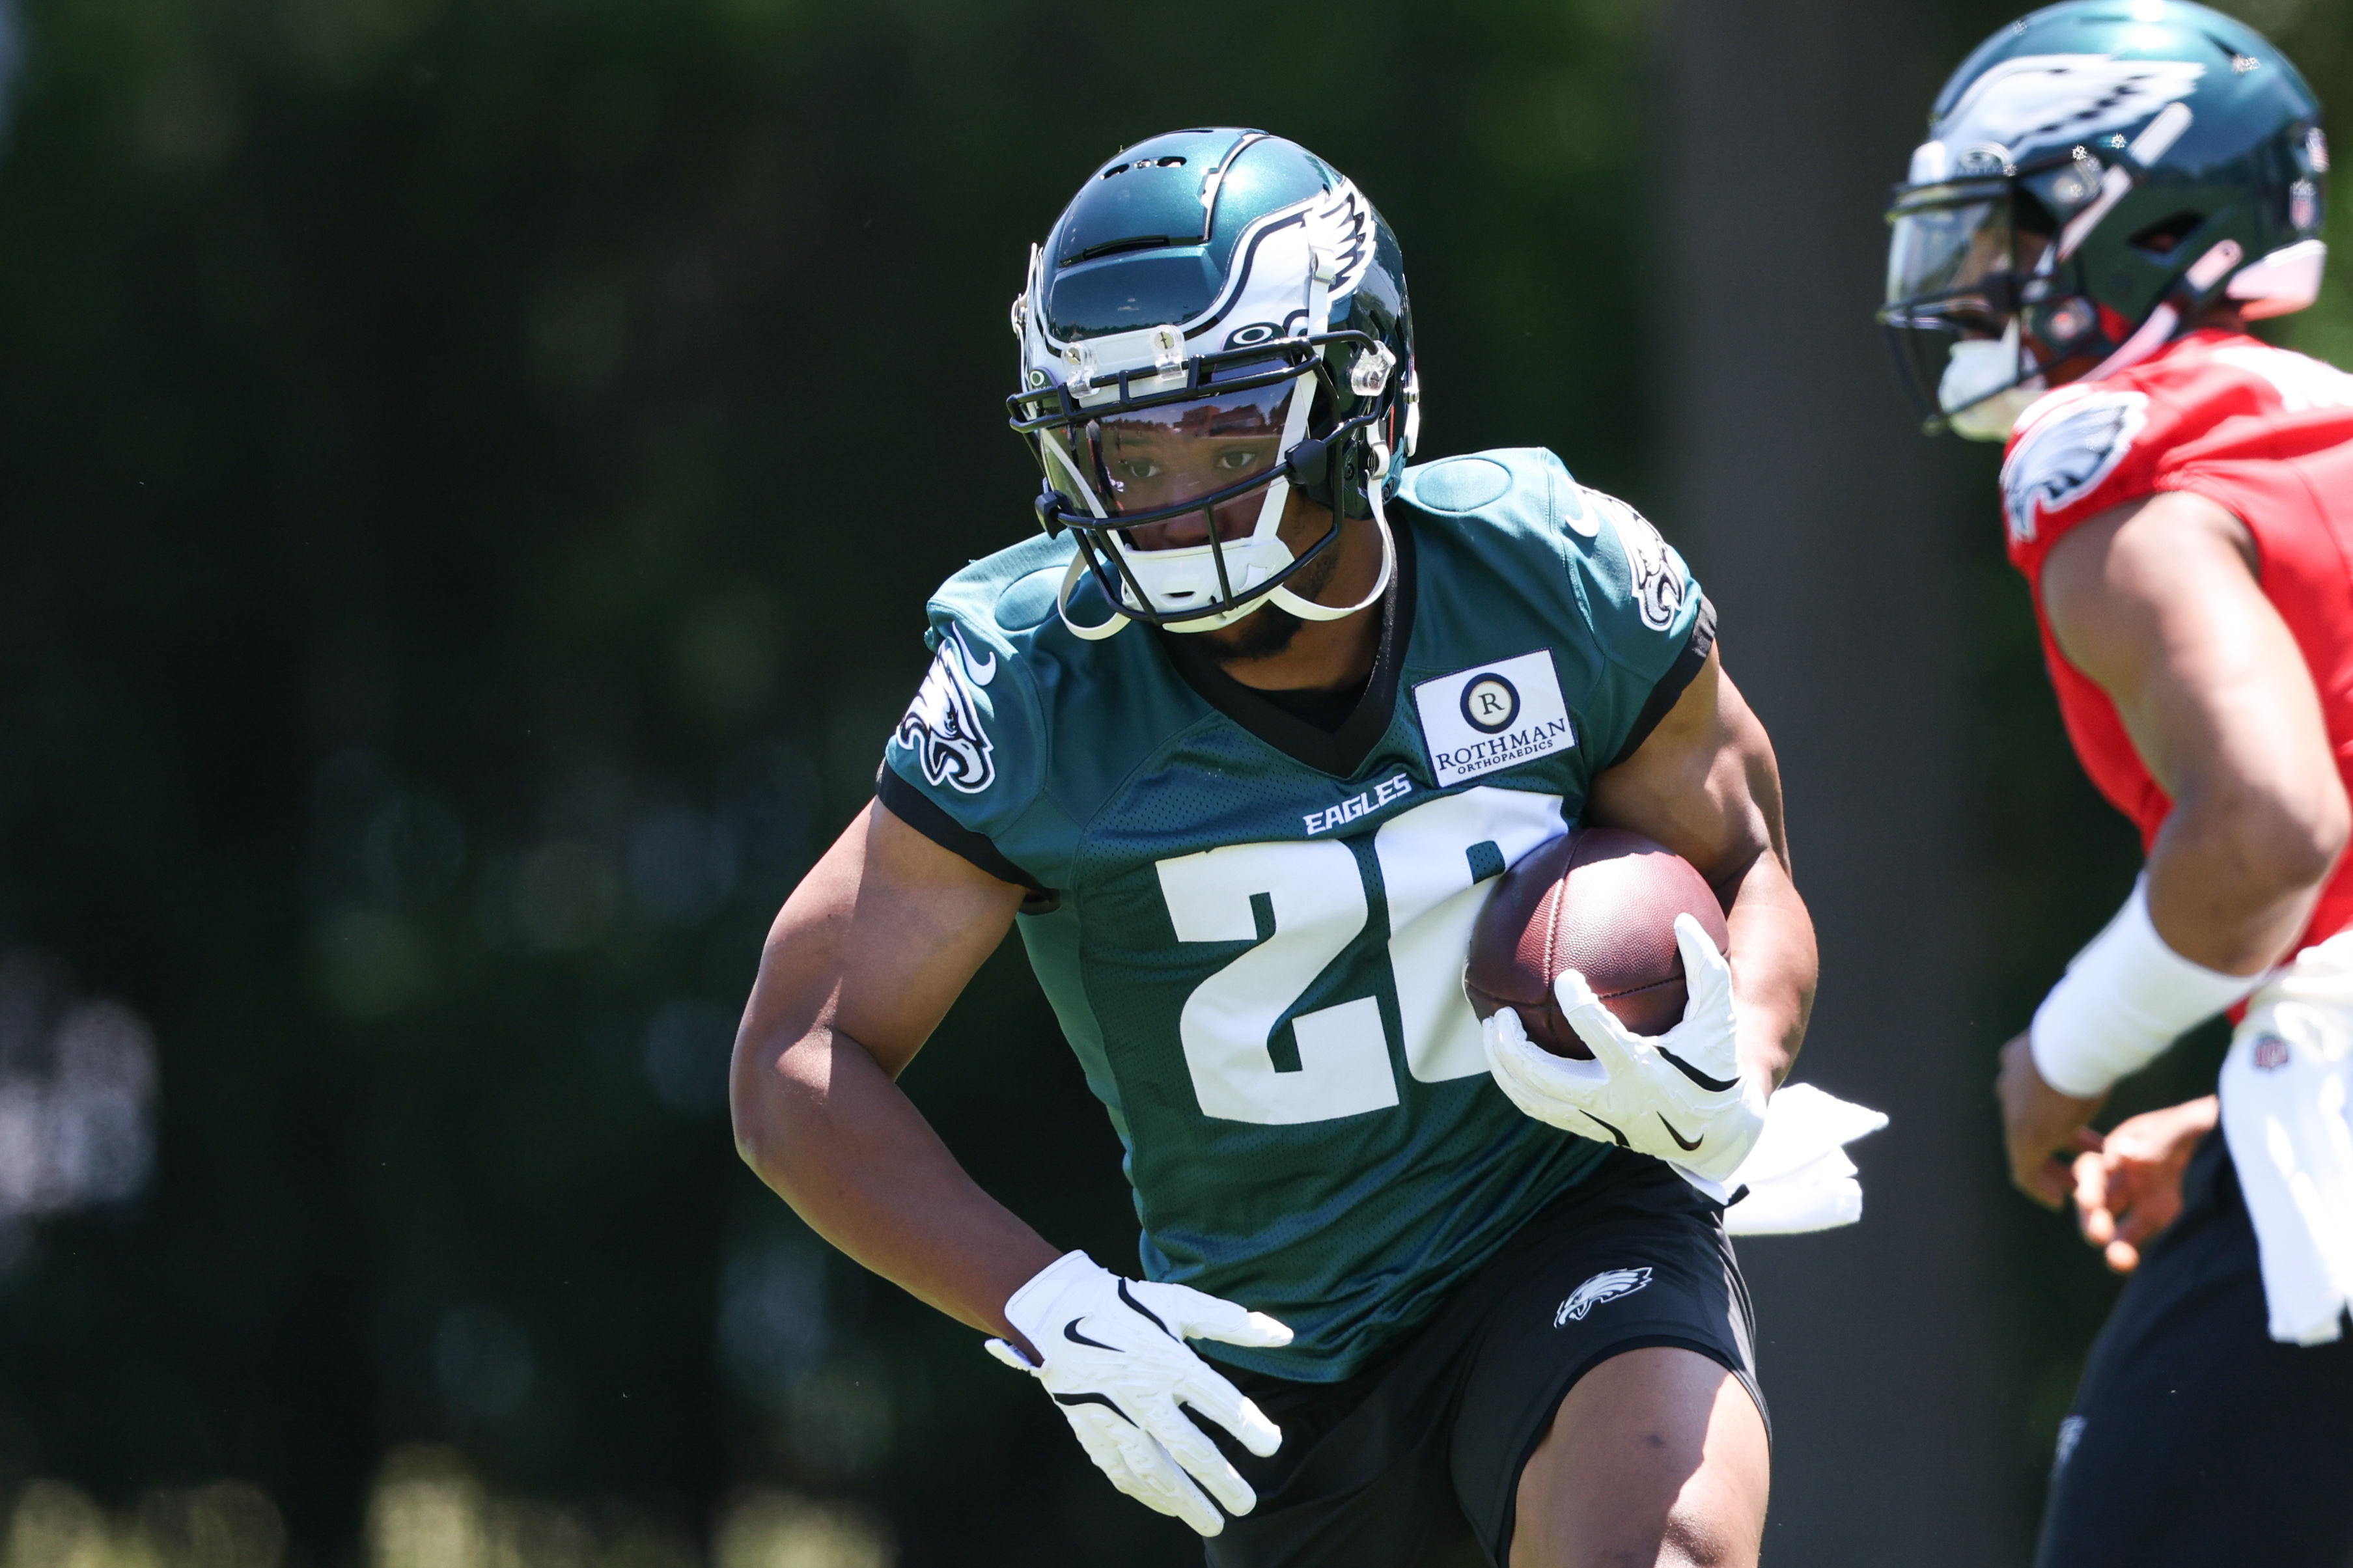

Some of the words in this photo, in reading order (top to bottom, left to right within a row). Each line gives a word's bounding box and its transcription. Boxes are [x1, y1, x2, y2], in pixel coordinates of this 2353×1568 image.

[1478, 693, 1505, 715] R
[1436, 718, 1565, 771] ROTHMAN
[1458, 739, 1553, 775] ORTHOPAEDICS
[1303, 773, 1412, 836] EAGLES
